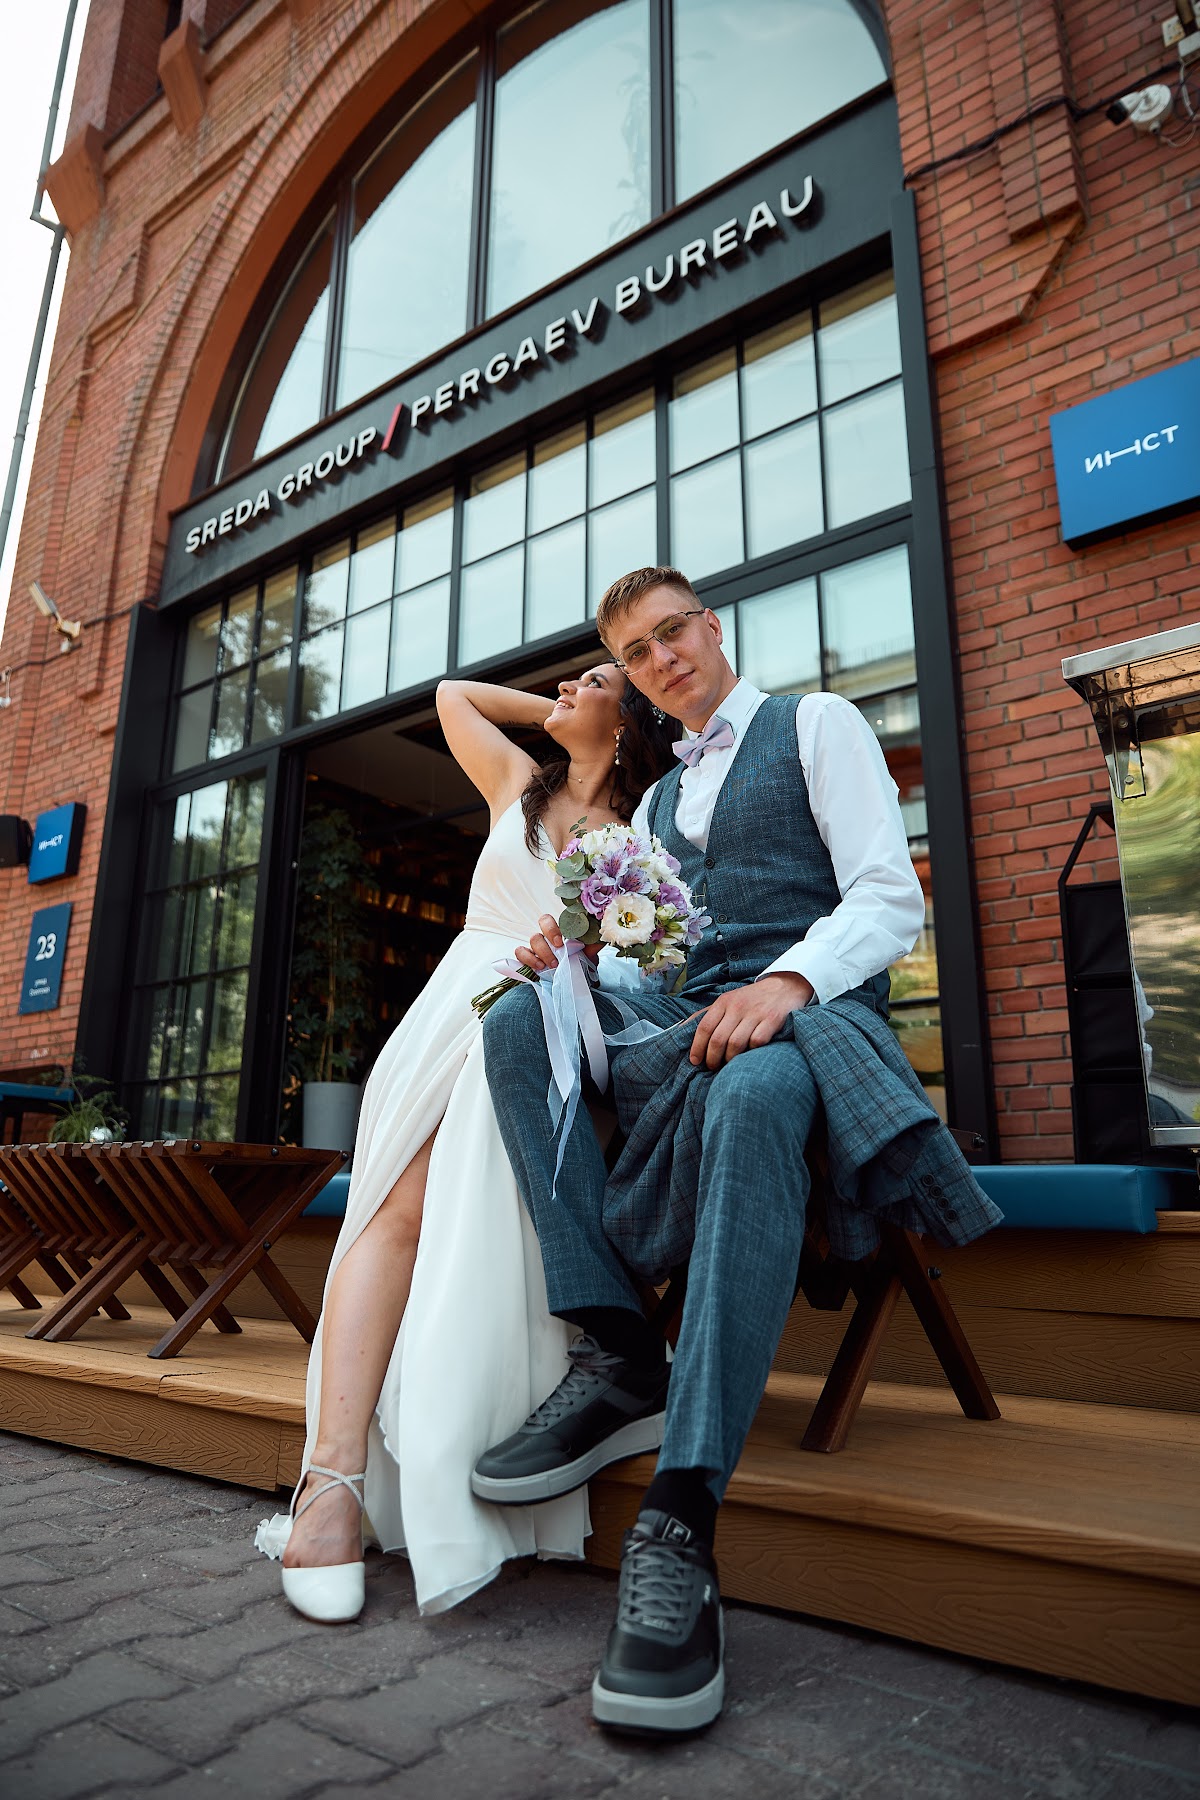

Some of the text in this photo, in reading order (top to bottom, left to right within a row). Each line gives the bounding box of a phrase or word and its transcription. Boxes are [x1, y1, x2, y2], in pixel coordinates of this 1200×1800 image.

[185, 488, 270, 553] SREDA
[277, 427, 378, 501] GROUP
[410, 297, 600, 428] PERGAEV
[615, 175, 813, 314] BUREAU
[1084, 424, 1179, 473] ИНСТ
[35, 932, 57, 961] 23
